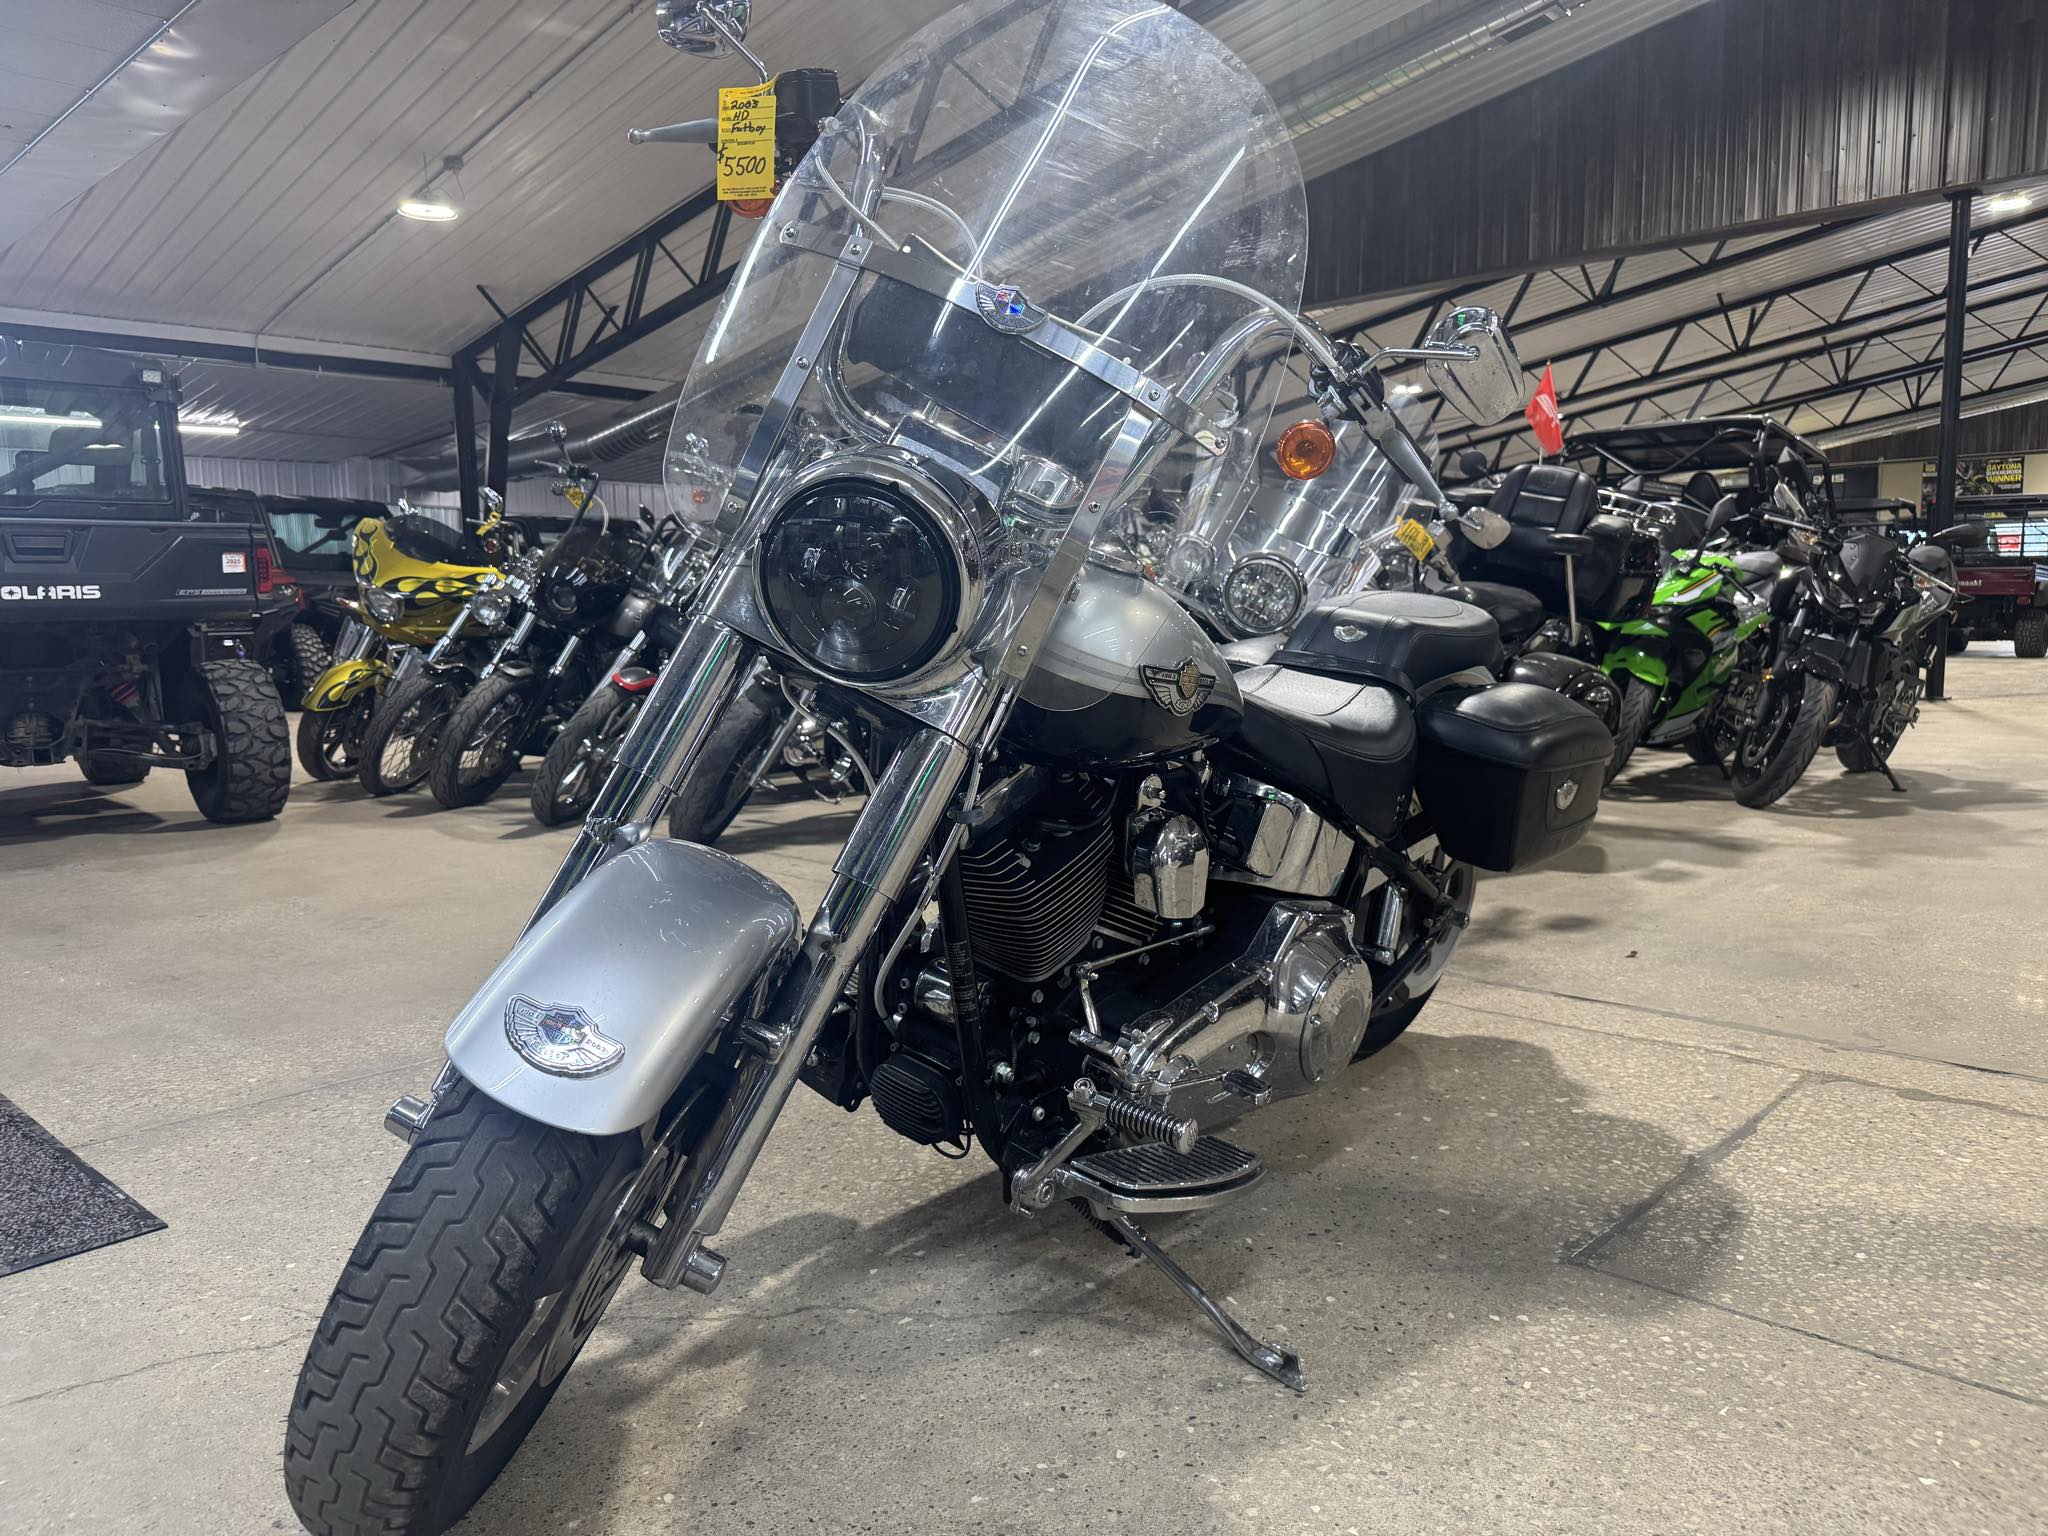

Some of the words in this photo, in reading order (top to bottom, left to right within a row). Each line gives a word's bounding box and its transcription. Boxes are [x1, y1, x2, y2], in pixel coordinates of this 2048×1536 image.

[730, 99, 759, 110] 2003
[733, 109, 750, 121] HD
[731, 121, 766, 136] Fatboy
[1986, 463, 2022, 472] DAYTONA
[1986, 474, 2022, 483] WINNER
[0, 585, 101, 600] OLARIS
